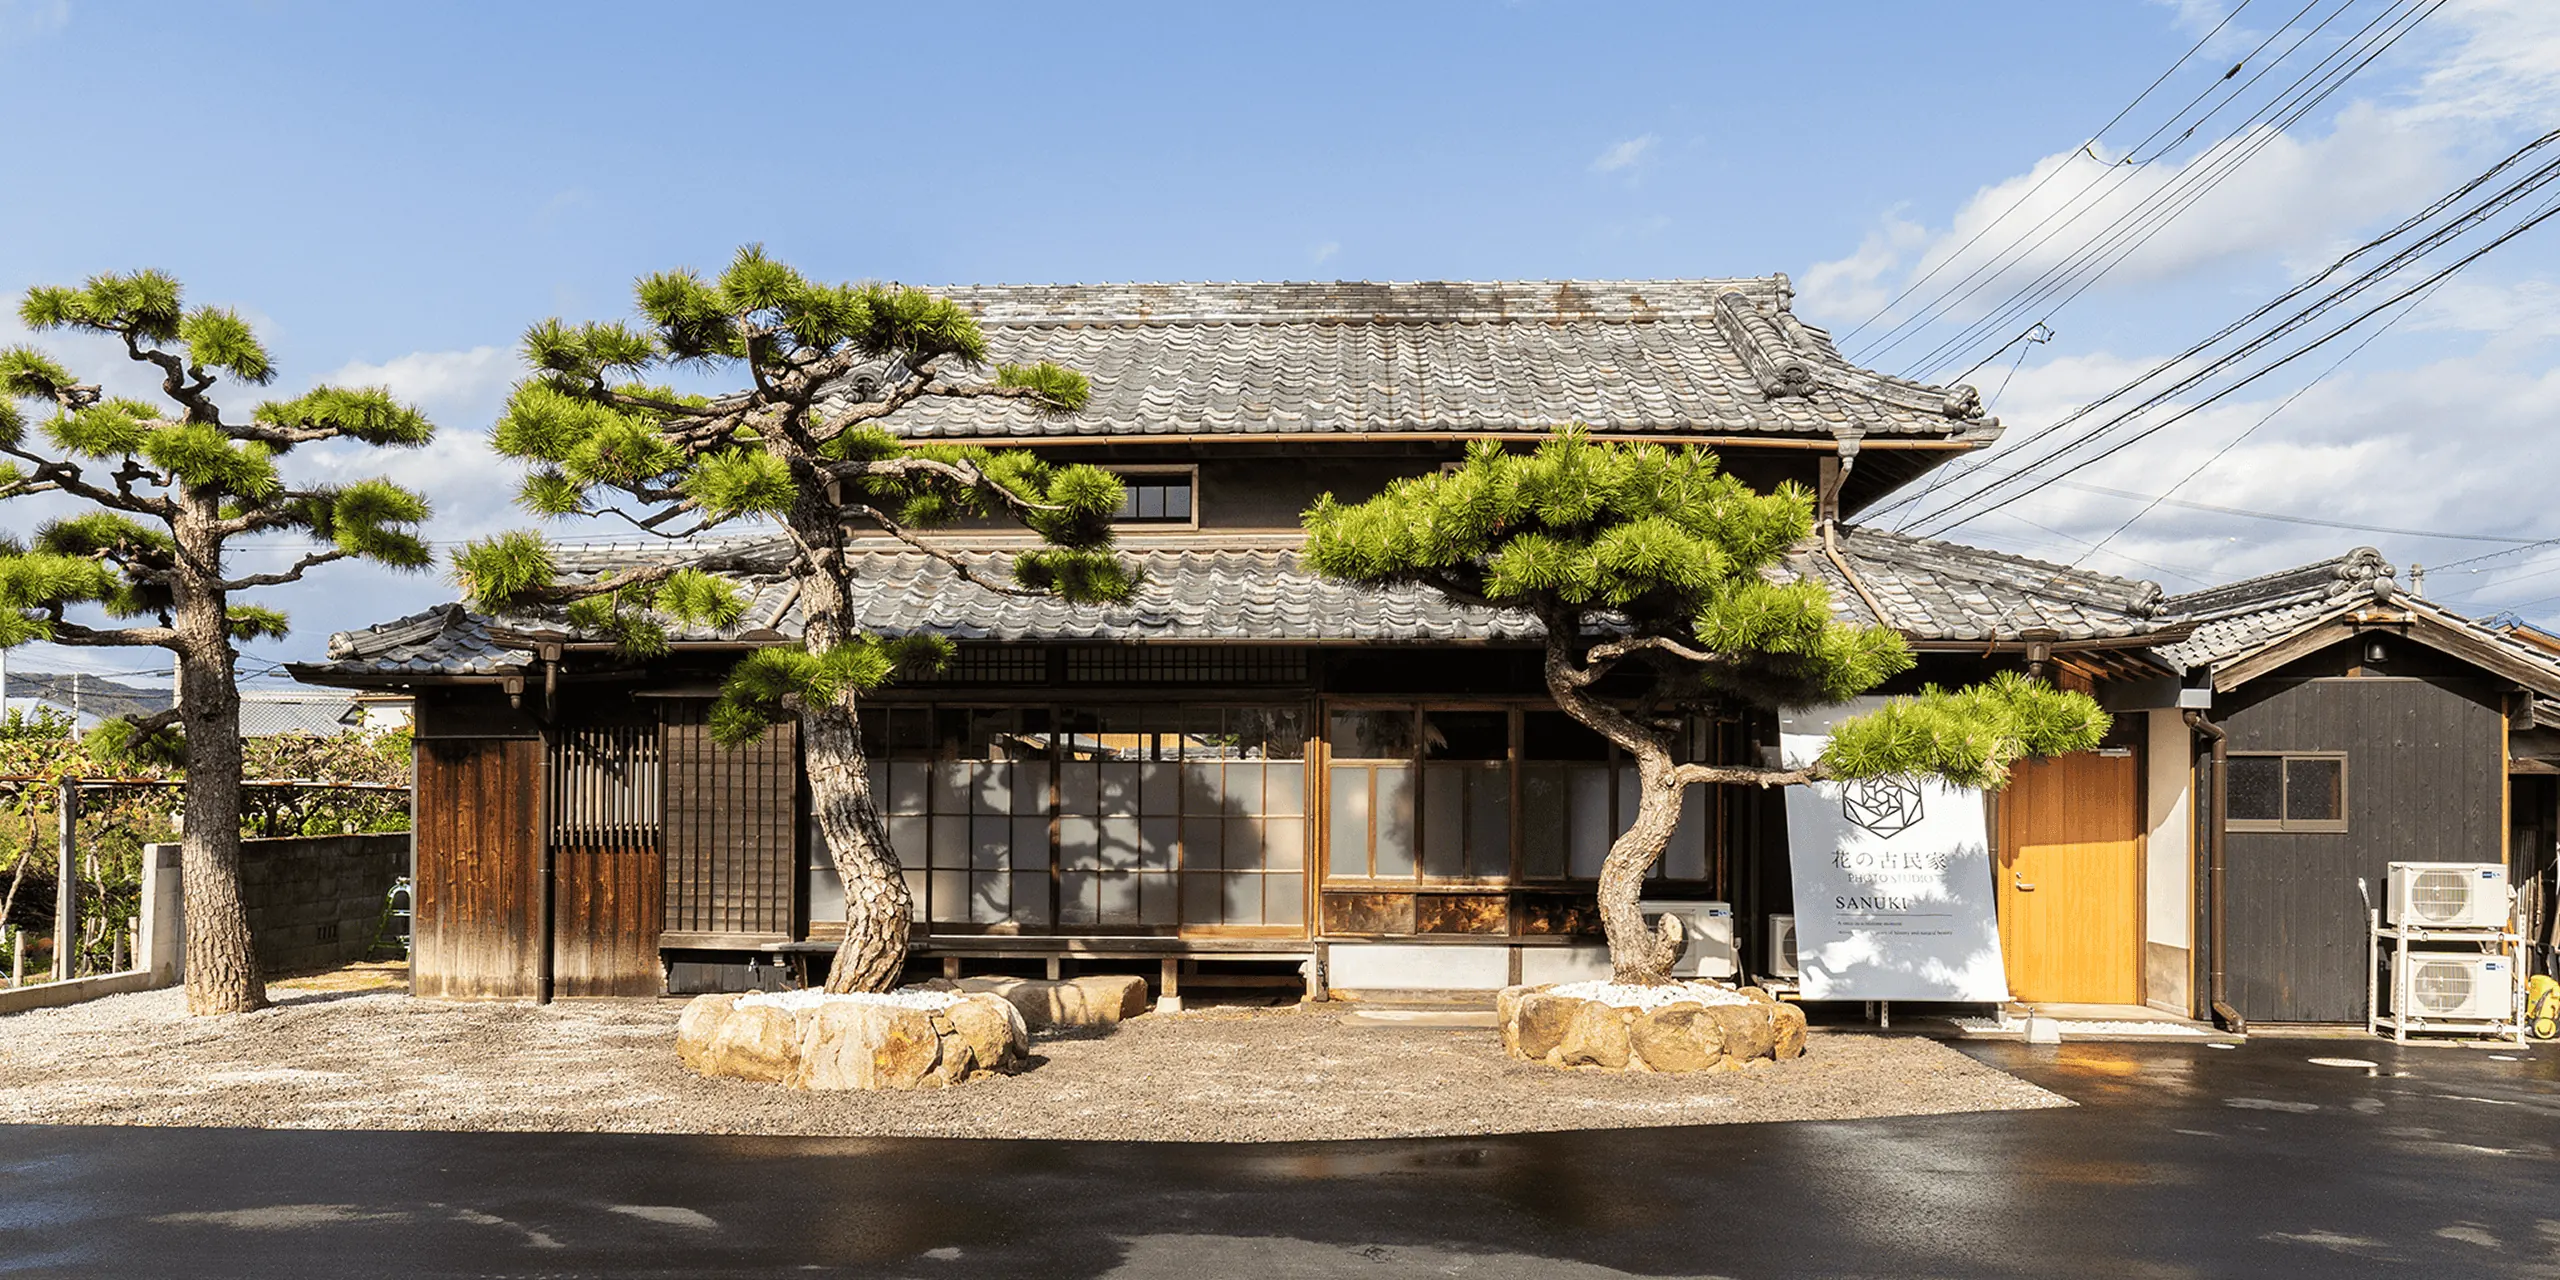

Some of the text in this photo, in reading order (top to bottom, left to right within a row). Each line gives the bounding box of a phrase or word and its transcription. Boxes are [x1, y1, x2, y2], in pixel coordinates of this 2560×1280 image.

[1831, 850, 1948, 871] 花の古民家
[1848, 873, 1934, 884] PHOTO STUDIO
[1835, 896, 1907, 910] SANUKI
